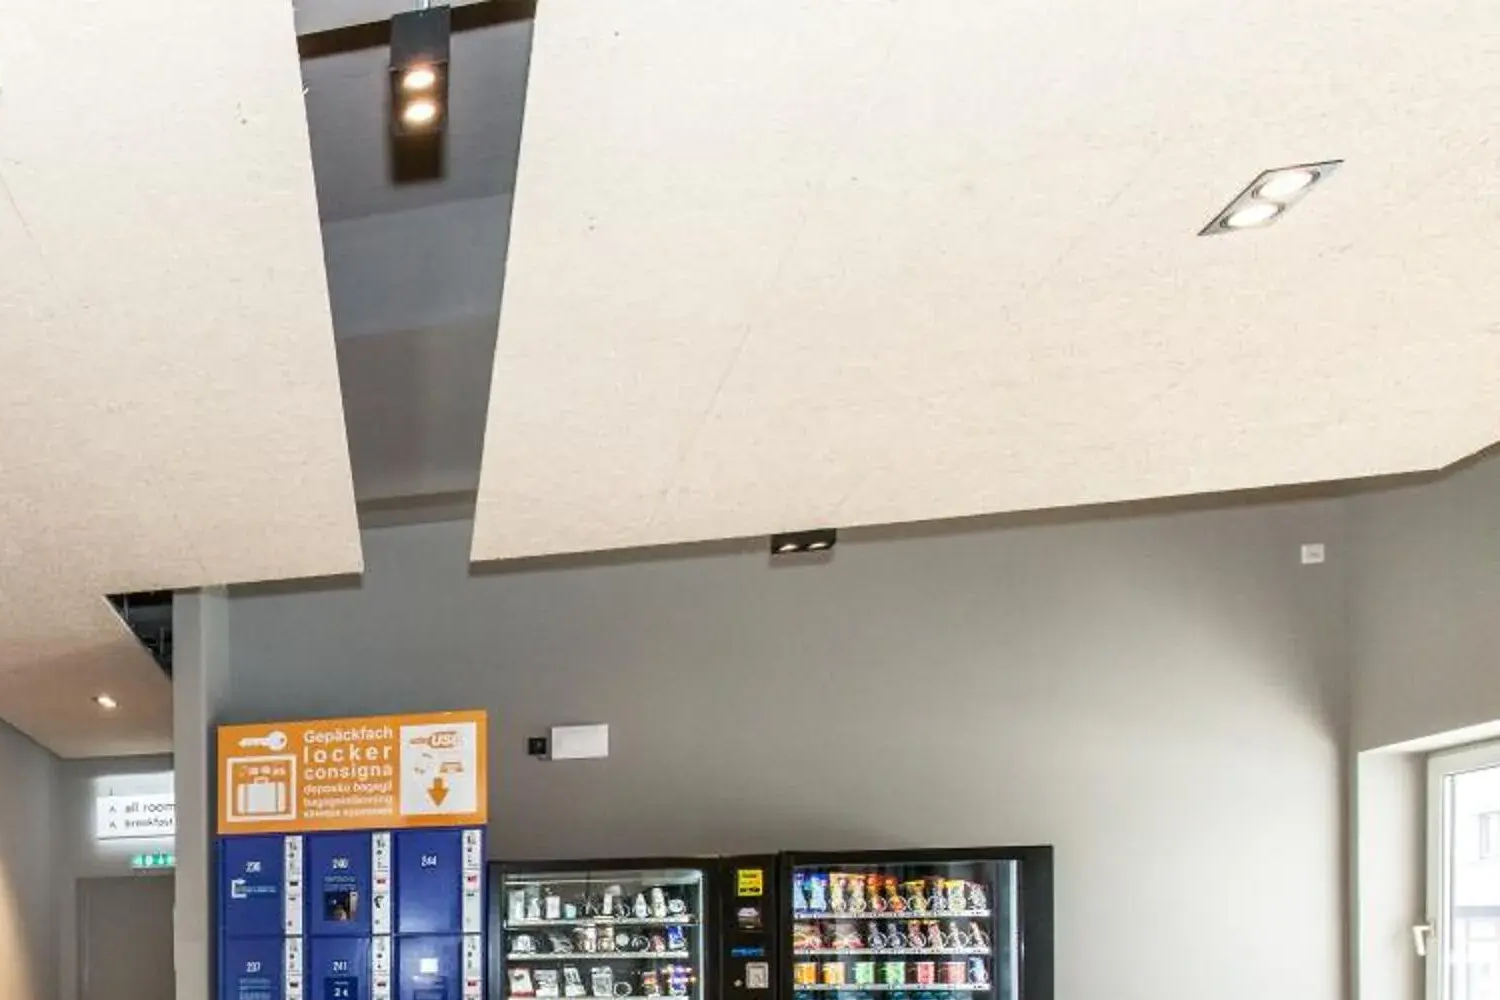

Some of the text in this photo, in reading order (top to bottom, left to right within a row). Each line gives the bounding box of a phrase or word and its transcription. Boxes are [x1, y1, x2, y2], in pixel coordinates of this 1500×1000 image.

[303, 725, 393, 744] Gepäckfach
[303, 743, 393, 764] locker
[304, 761, 393, 781] consigna
